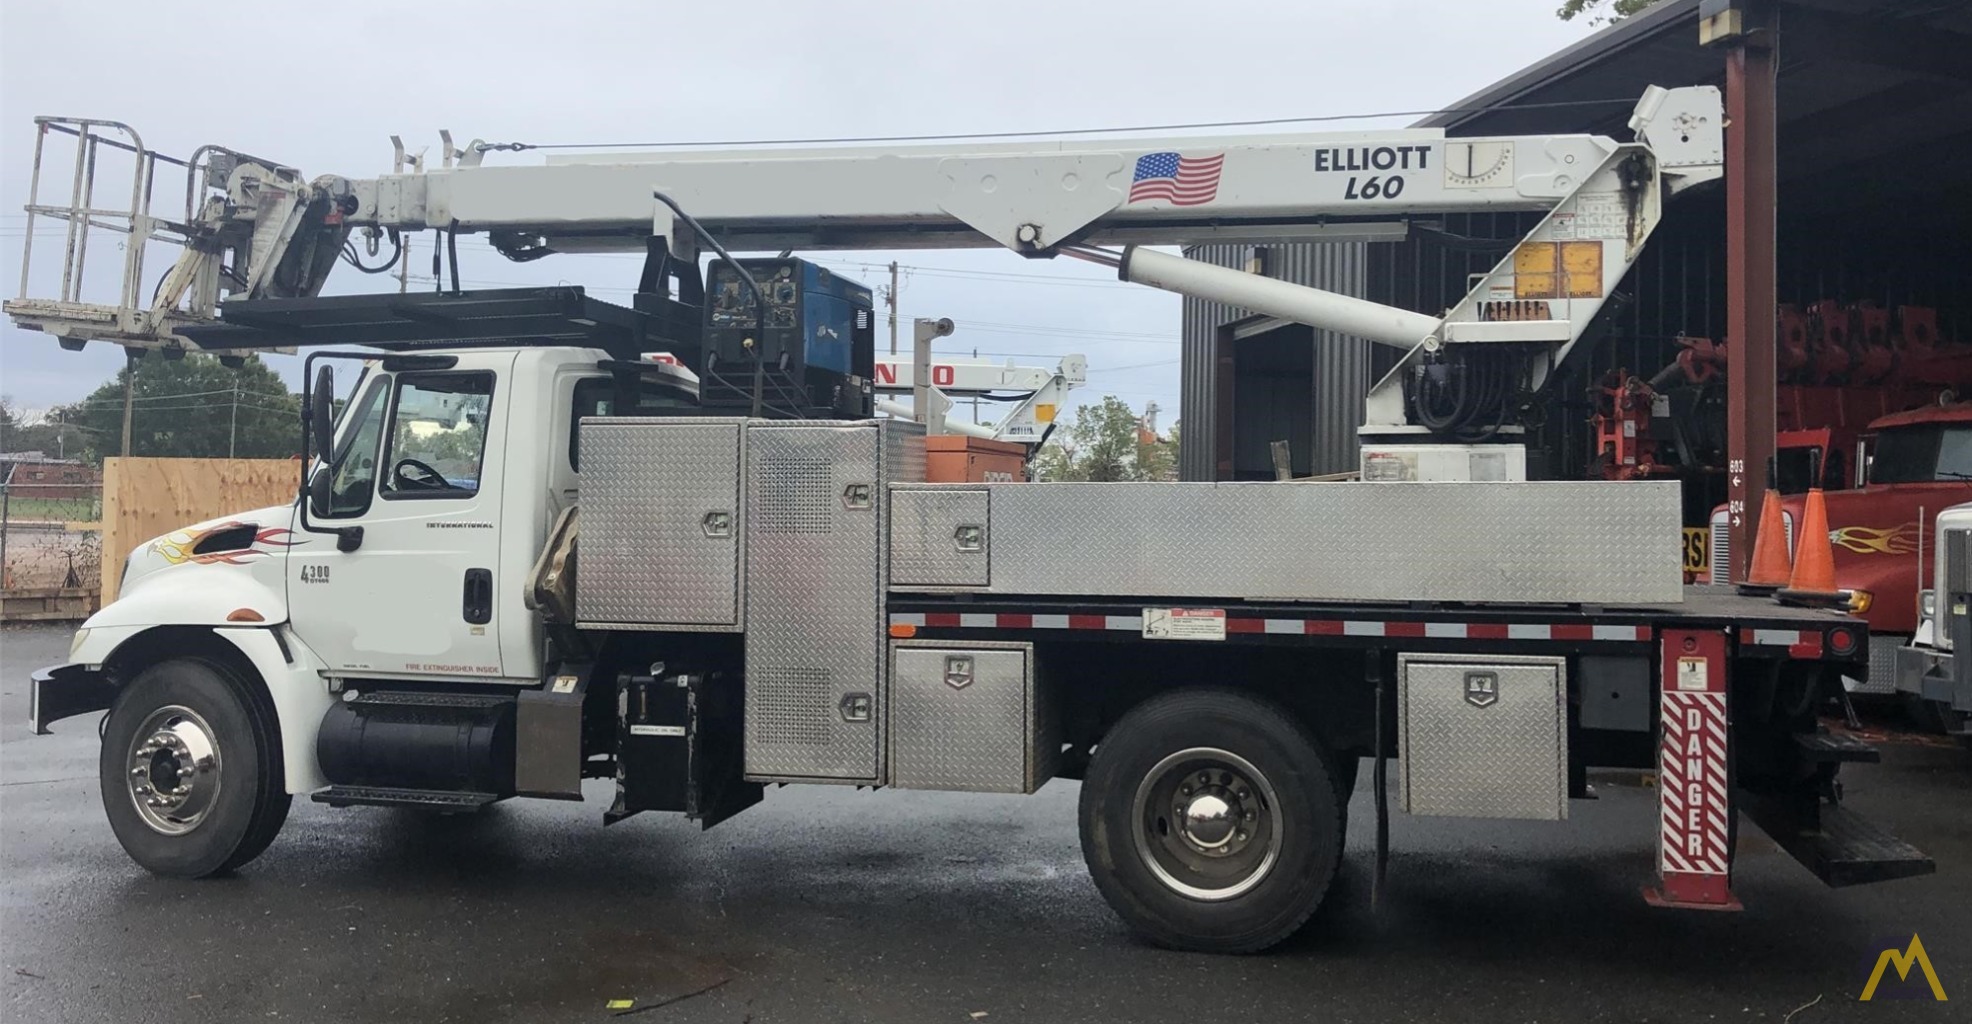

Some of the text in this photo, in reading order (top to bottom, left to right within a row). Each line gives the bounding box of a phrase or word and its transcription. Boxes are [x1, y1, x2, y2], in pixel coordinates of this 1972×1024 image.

[1315, 146, 1431, 171] ELLIOTT
[1344, 175, 1404, 199] L60
[1729, 460, 1744, 473] 603
[1729, 500, 1744, 513] 604
[426, 521, 494, 529] INTERNATIONAL
[300, 564, 330, 584] 4300
[423, 664, 473, 672] EXTINGUISHER
[1687, 708, 1702, 856] DANGER
